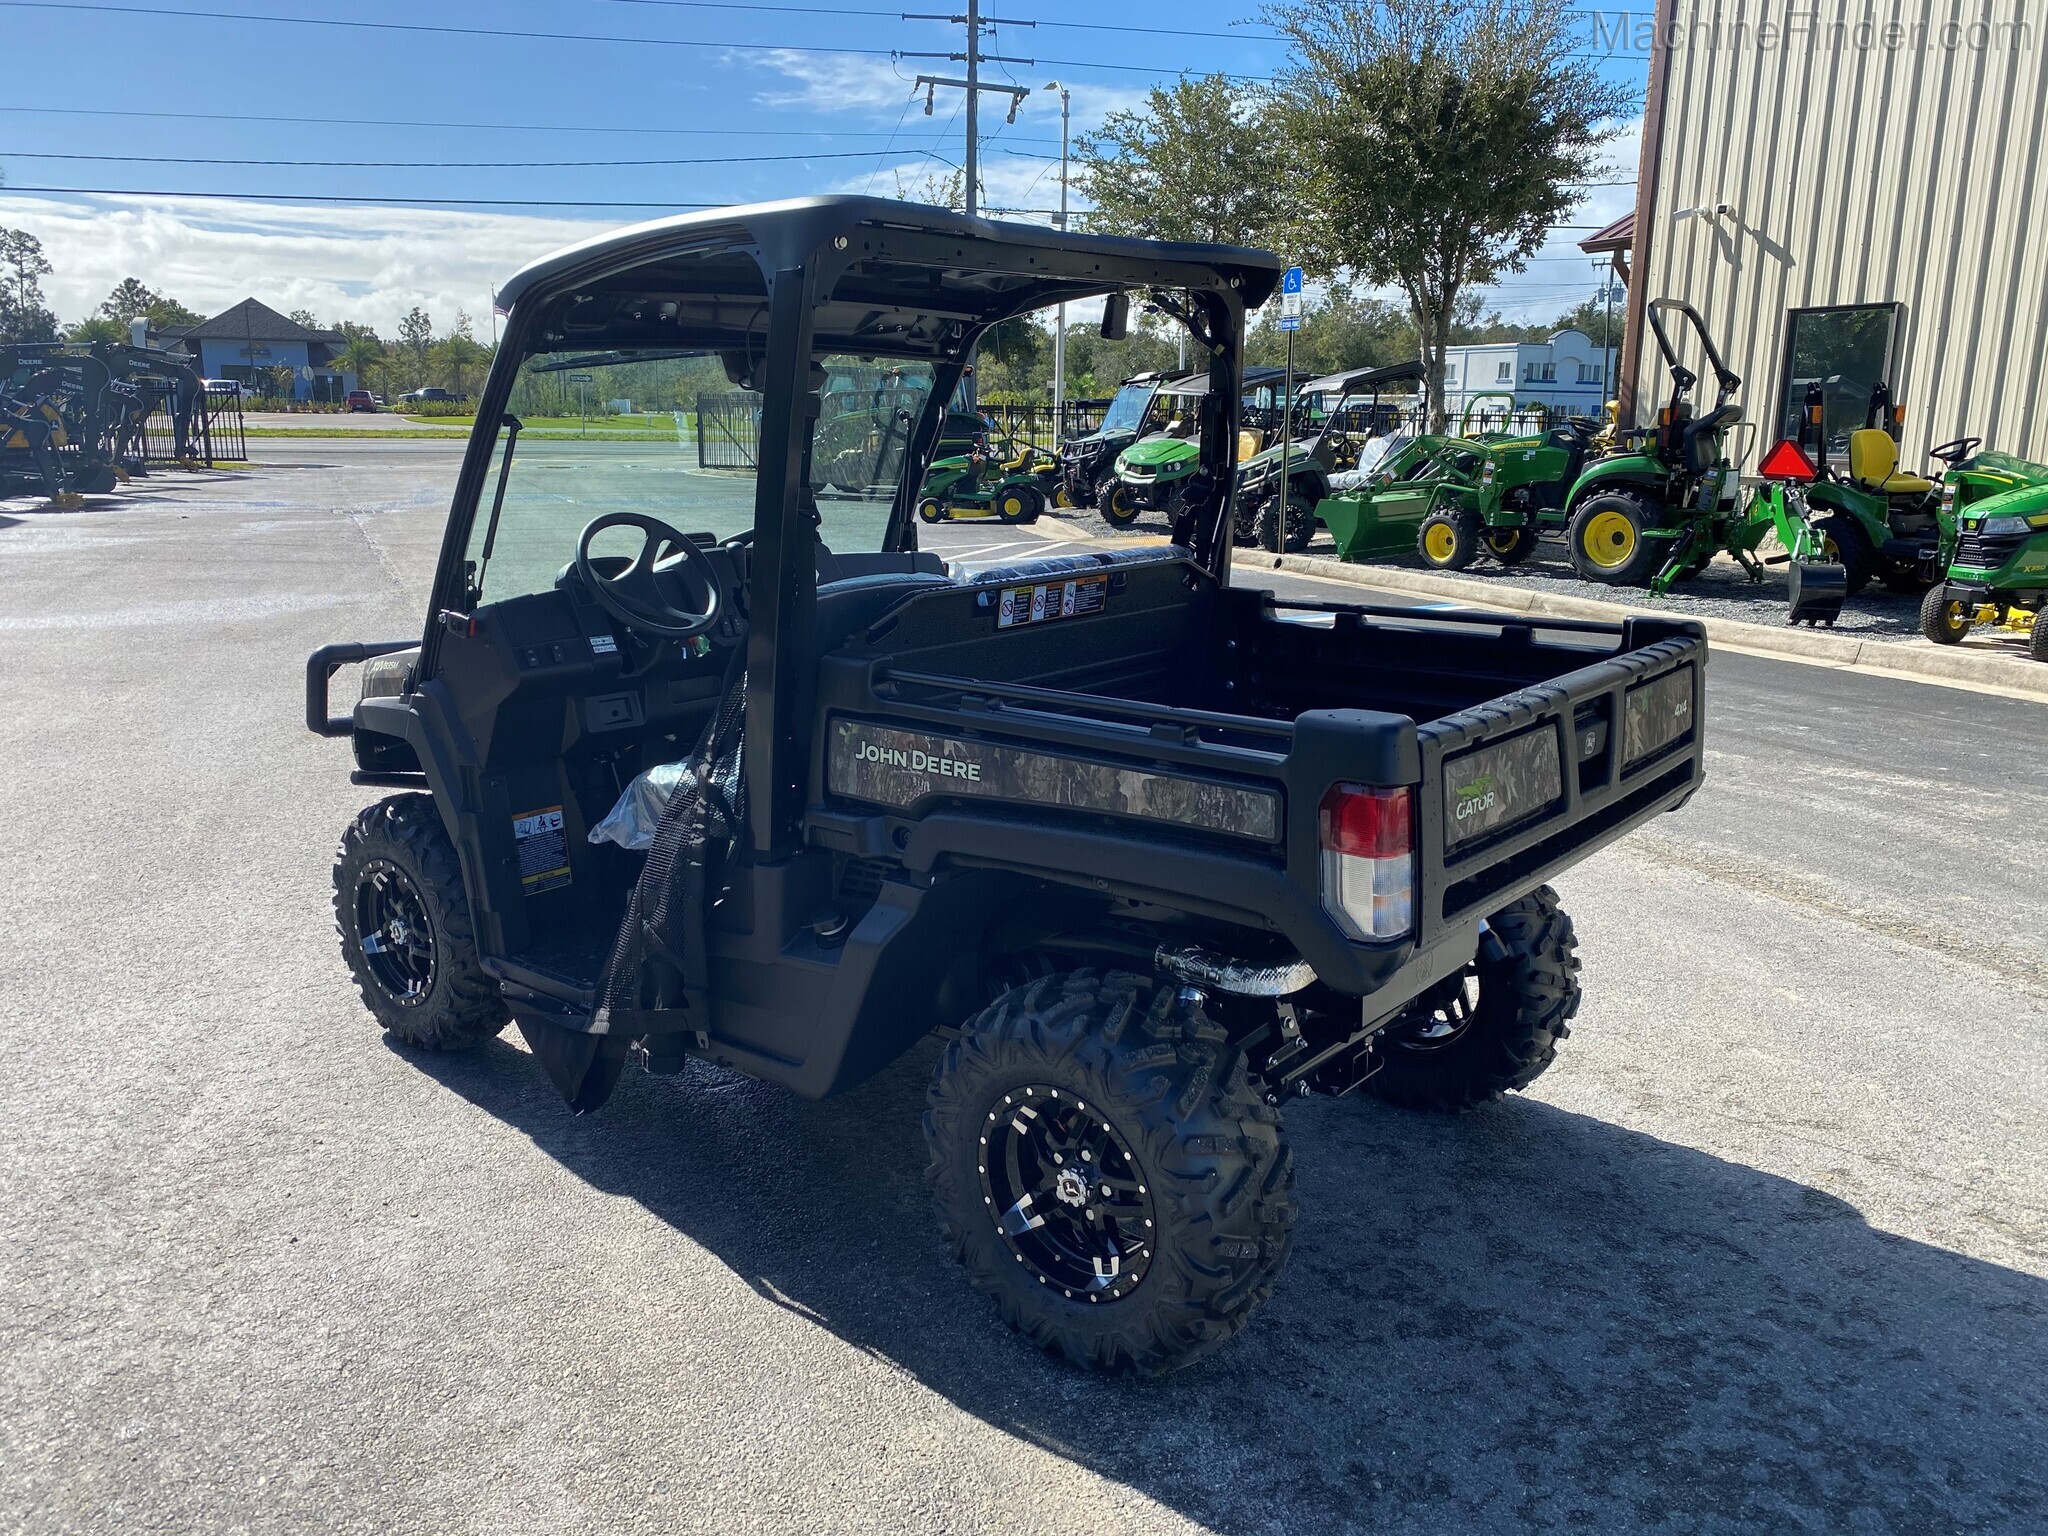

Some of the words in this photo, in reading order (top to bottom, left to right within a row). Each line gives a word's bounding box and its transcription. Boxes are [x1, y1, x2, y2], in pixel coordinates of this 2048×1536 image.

[128, 359, 151, 369] DEERE
[2023, 564, 2047, 574] X350
[855, 740, 907, 767] JOHN
[912, 750, 981, 781] DEERE
[1456, 791, 1495, 820] GATOR
